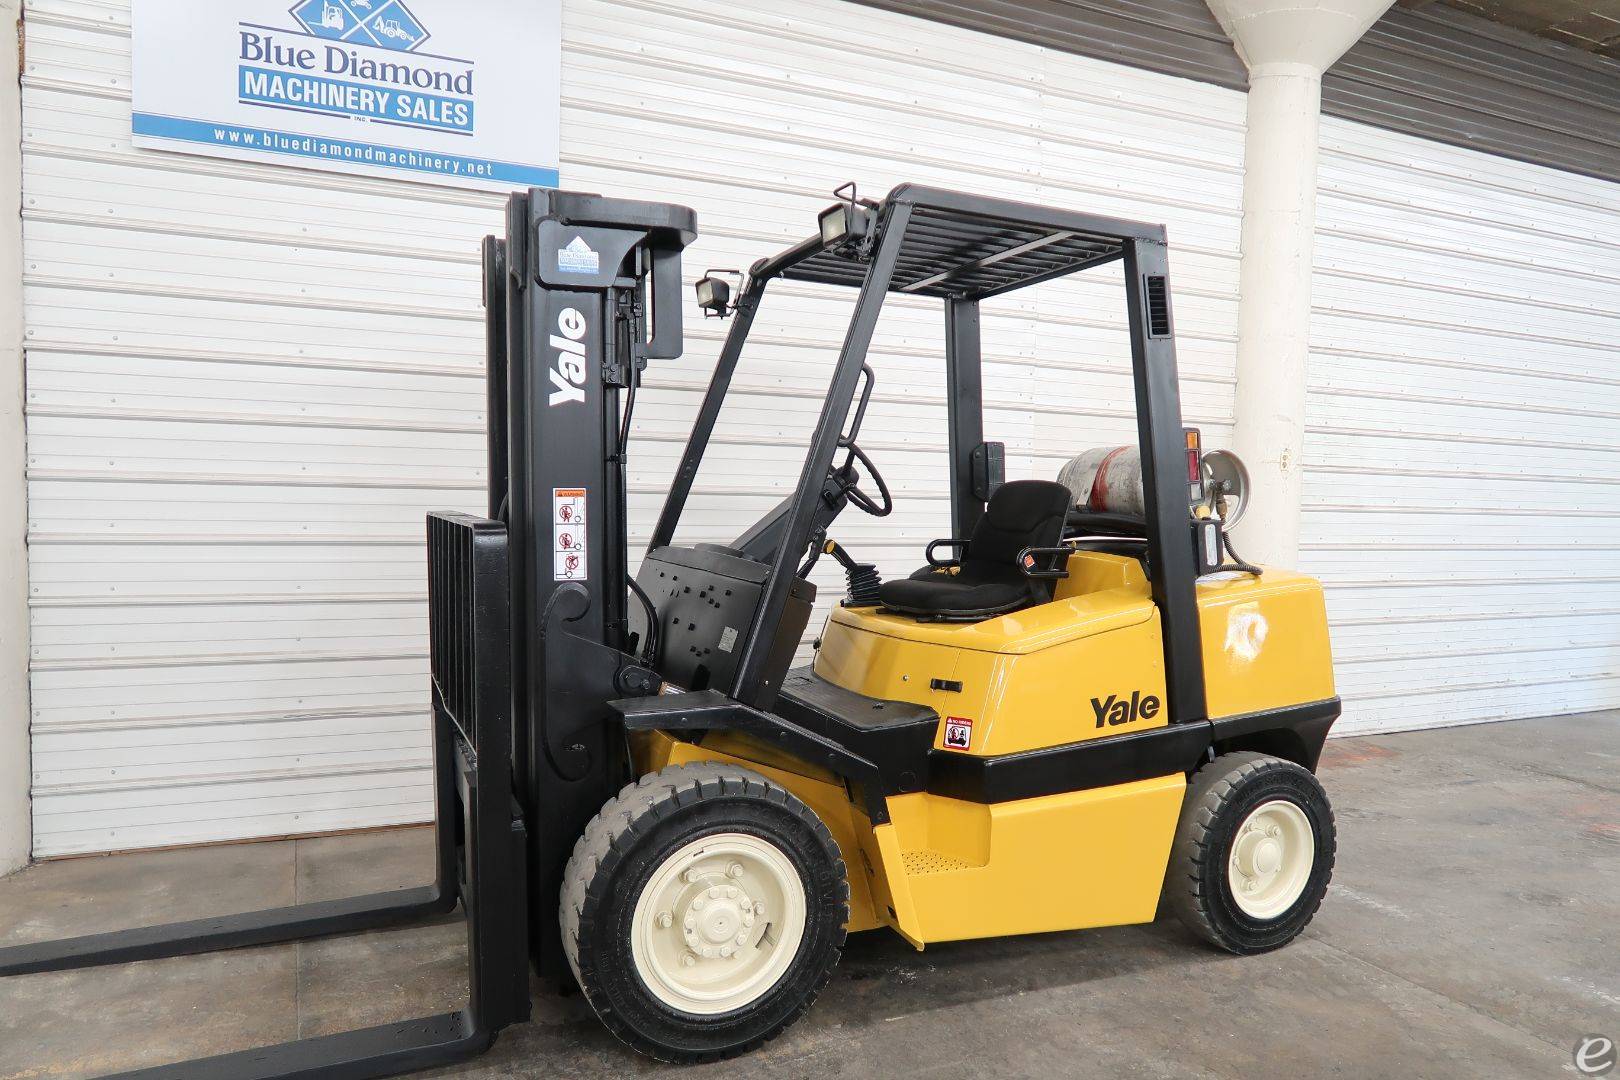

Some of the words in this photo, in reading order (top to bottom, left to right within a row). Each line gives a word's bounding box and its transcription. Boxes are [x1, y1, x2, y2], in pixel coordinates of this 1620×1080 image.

[239, 31, 316, 70] Blue
[323, 45, 474, 95] Diamond
[244, 71, 390, 114] MACHINERY
[396, 94, 468, 126] SALES
[213, 129, 493, 176] www.bluediamondmachinery.net
[549, 307, 587, 406] Yale
[1090, 690, 1160, 729] Yale
